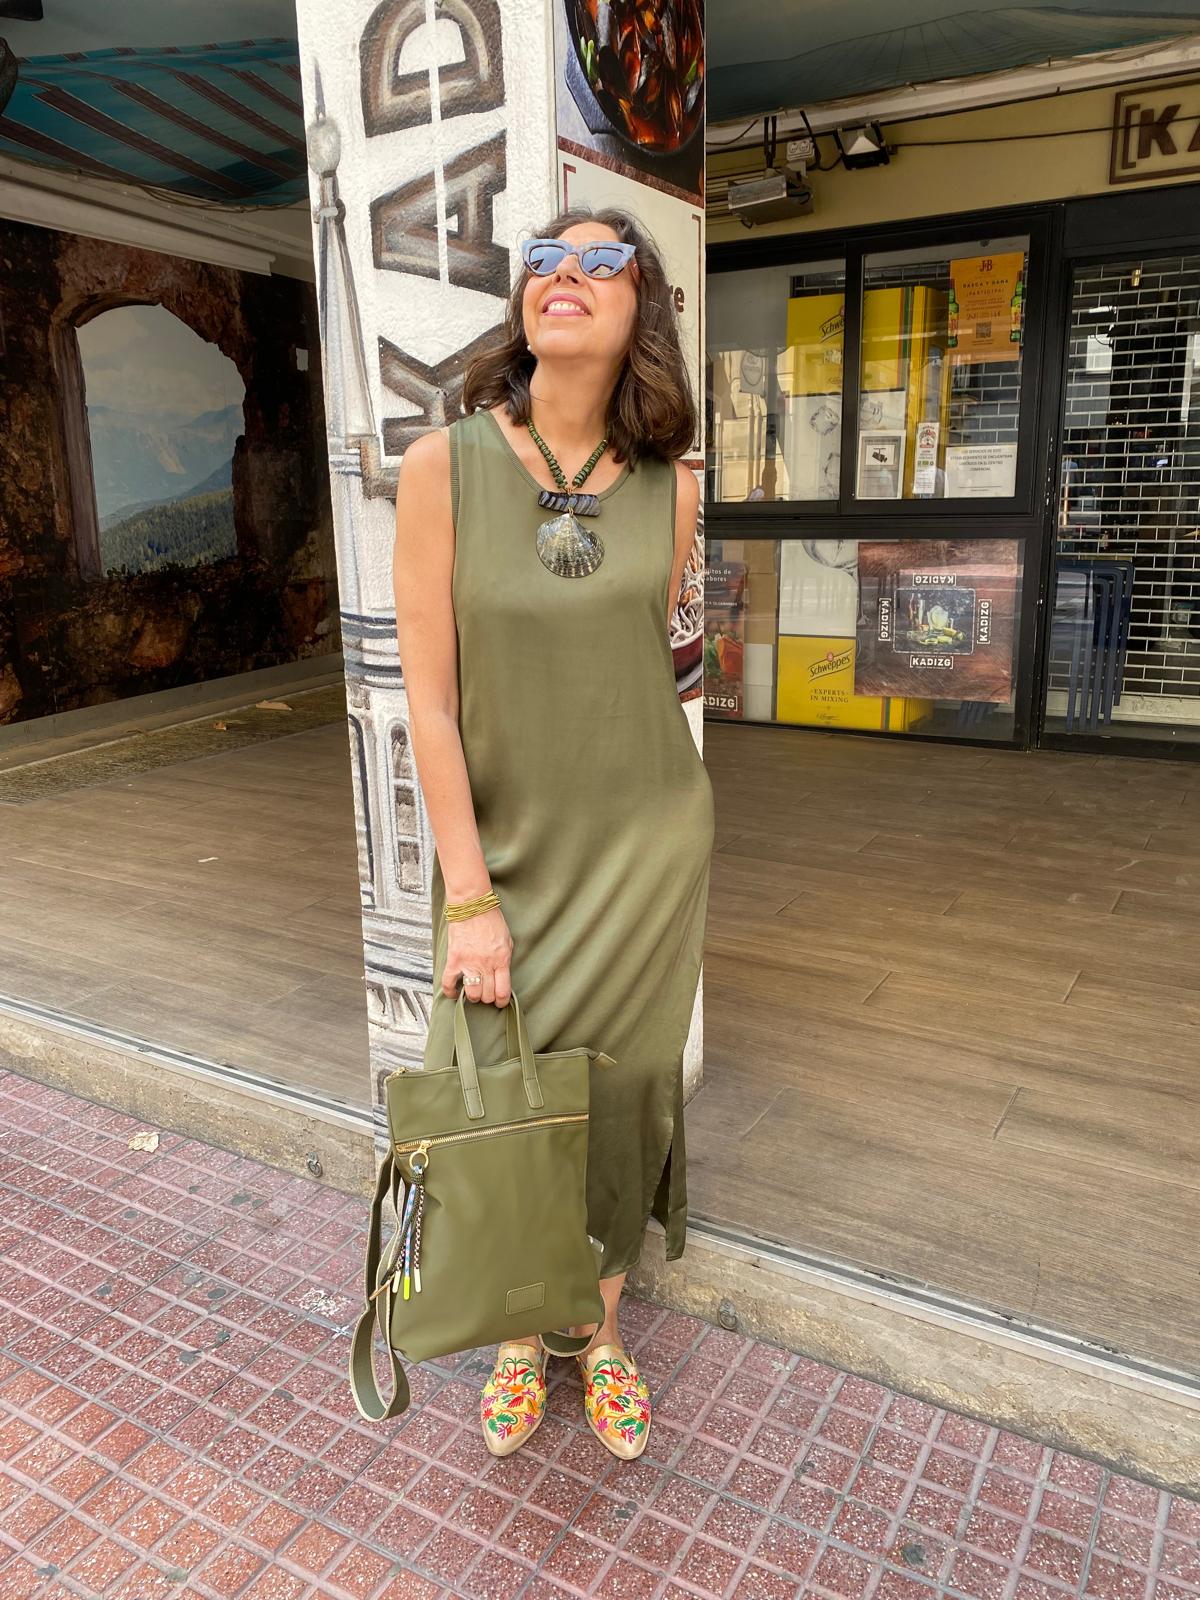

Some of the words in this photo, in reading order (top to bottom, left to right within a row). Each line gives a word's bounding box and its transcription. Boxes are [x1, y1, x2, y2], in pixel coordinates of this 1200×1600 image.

[915, 575, 954, 584] KADIZG
[881, 600, 889, 639] KADIZG
[980, 601, 990, 642] KADIZG
[809, 654, 850, 677] Schweppes
[912, 657, 951, 667] KADIZG
[814, 688, 845, 696] EXPERTS
[821, 695, 849, 703] MIXING
